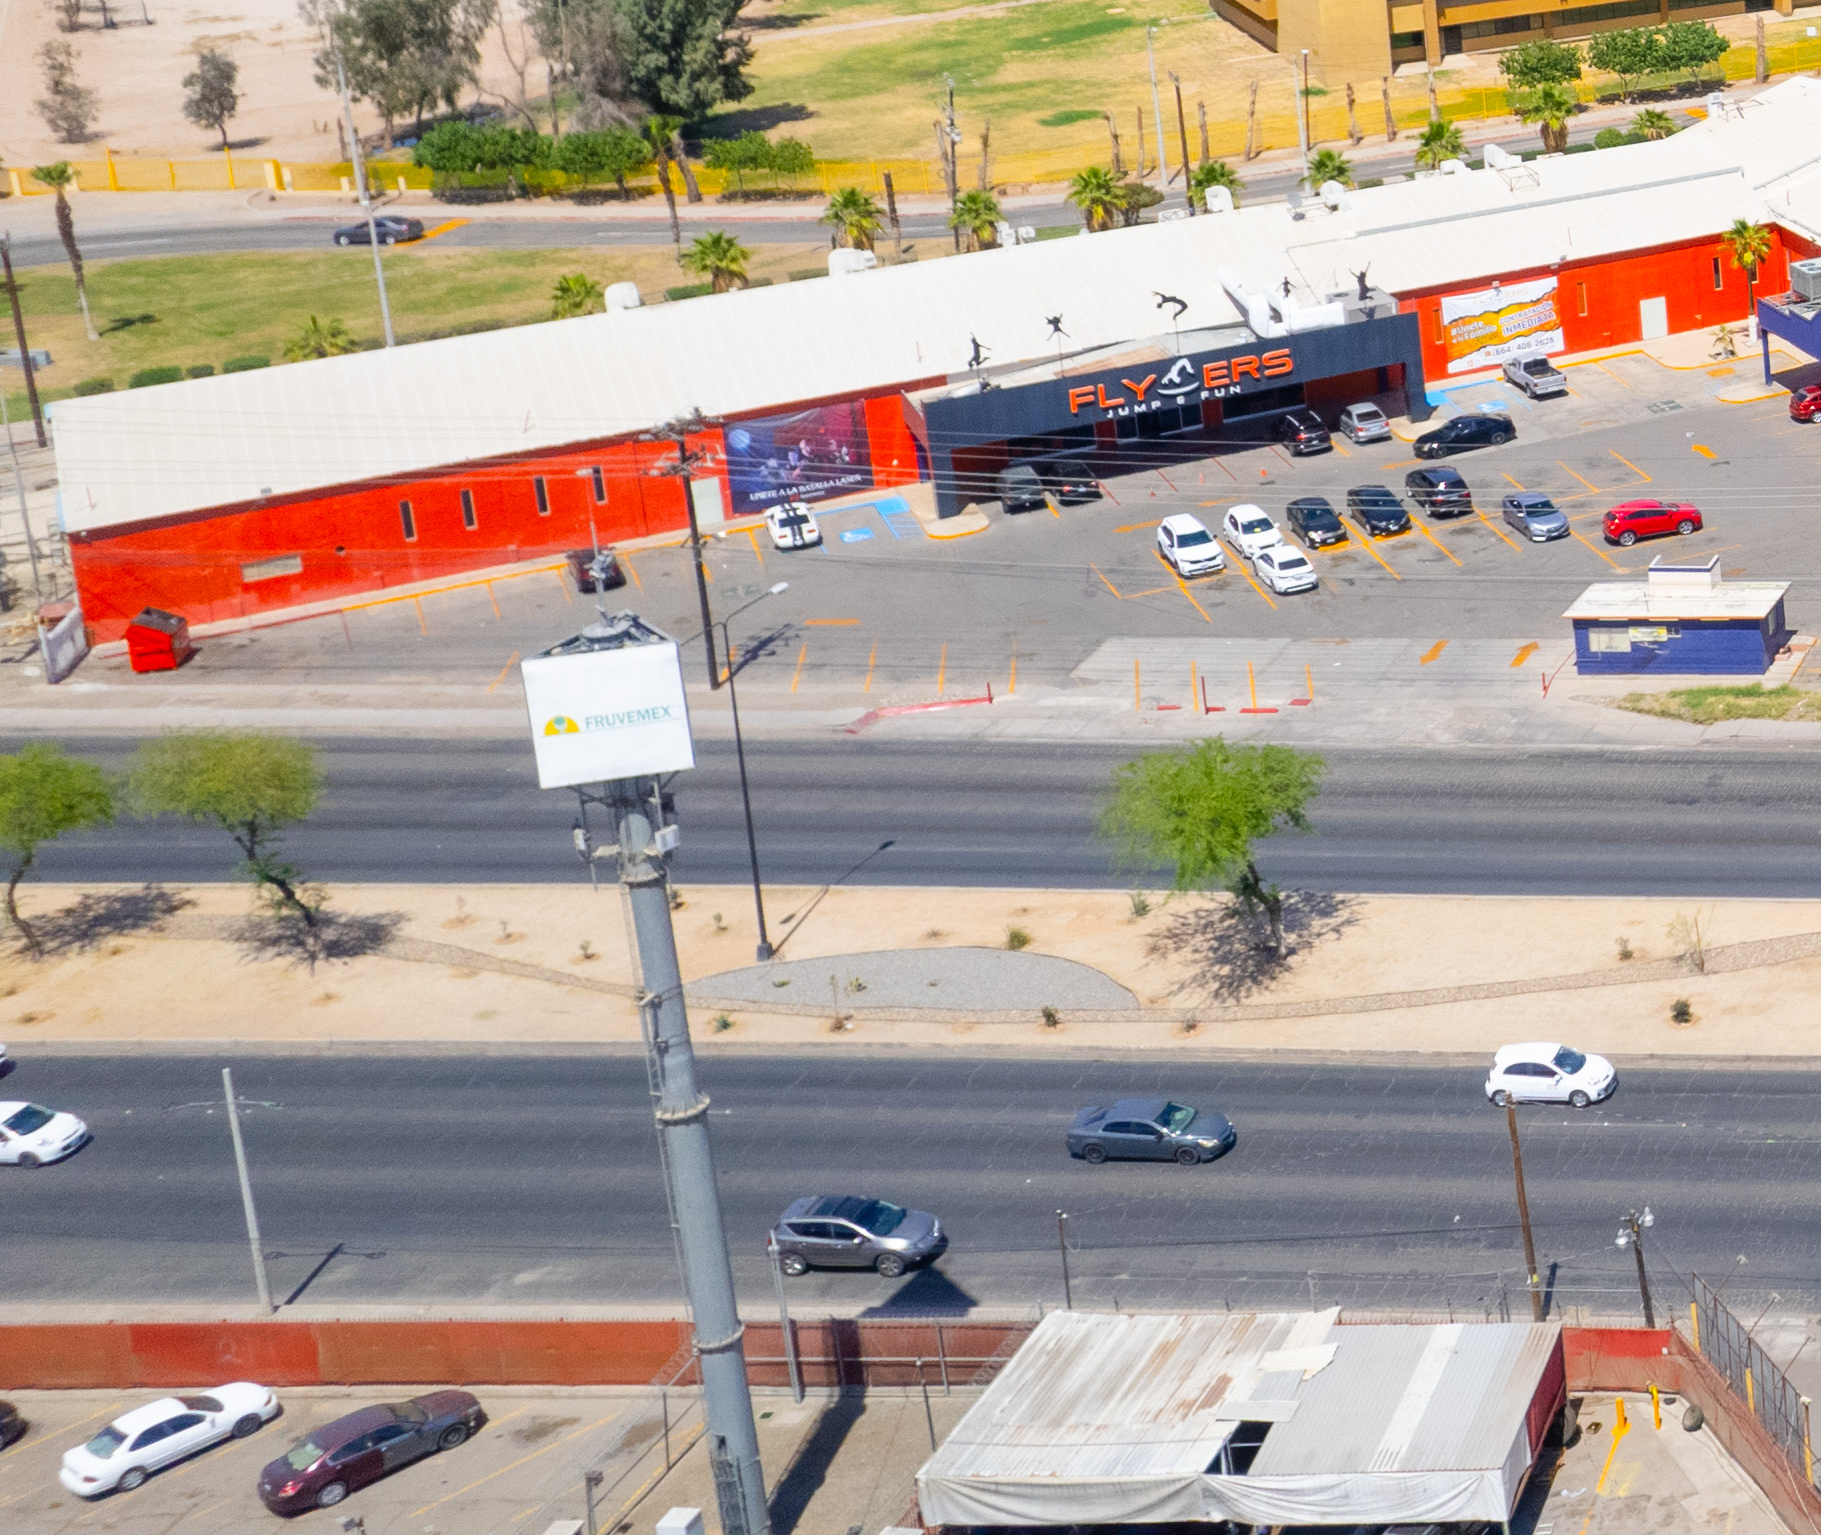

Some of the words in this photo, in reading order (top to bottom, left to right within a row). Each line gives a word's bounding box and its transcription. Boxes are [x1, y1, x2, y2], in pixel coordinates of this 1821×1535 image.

[1502, 311, 1556, 336] INMEDIATA
[1106, 400, 1162, 418] JUMP
[1201, 385, 1242, 401] FUN
[786, 485, 798, 495] LA
[584, 705, 672, 729] FRUVEMEX
